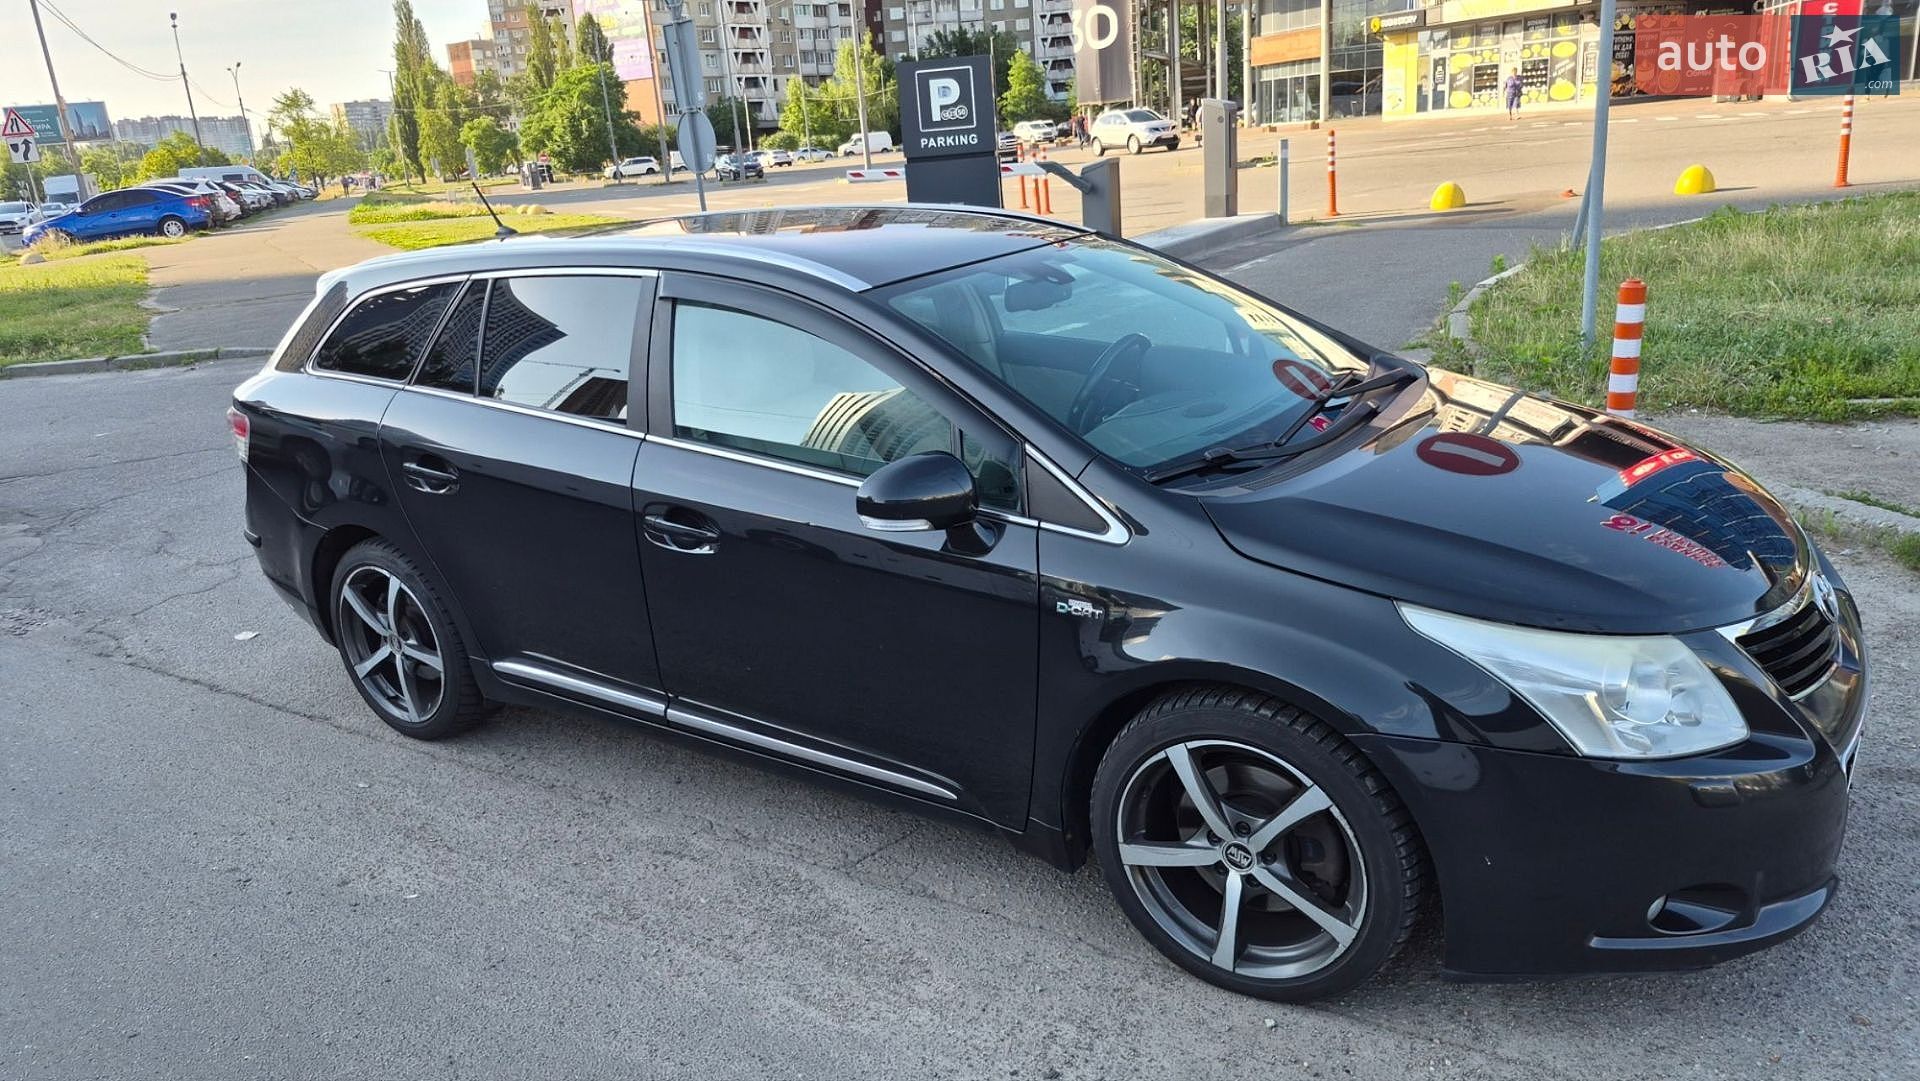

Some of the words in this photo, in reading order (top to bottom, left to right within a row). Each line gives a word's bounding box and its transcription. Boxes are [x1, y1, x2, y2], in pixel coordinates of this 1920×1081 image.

[929, 78, 960, 122] P
[920, 133, 979, 149] PARKING
[1056, 601, 1103, 620] D-CAT
